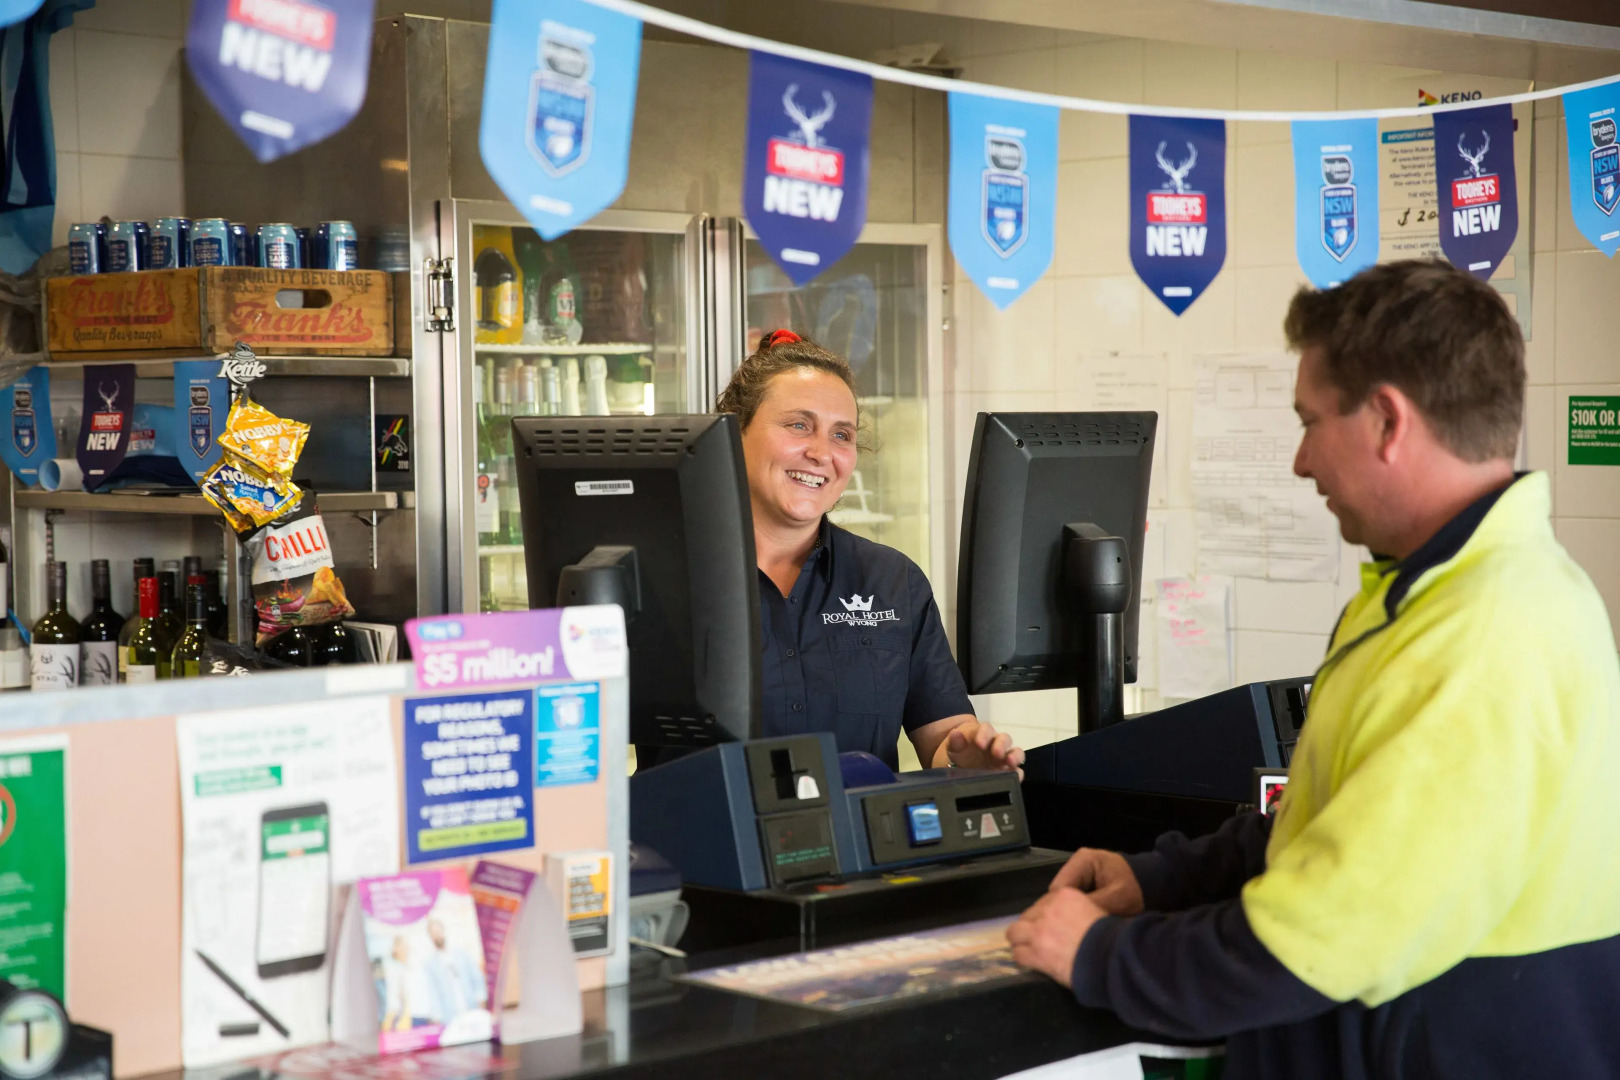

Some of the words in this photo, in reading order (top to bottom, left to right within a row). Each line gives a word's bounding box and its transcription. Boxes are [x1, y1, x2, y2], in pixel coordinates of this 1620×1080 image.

[219, 22, 333, 93] NEW
[1441, 90, 1482, 105] KENO
[1592, 124, 1614, 136] brydens
[1594, 154, 1618, 174] NSW
[763, 175, 843, 222] NEW
[1456, 179, 1496, 200] TOOHEYS
[1152, 196, 1201, 217] TOOHEYS
[1325, 197, 1353, 214] NSW
[1453, 204, 1501, 237] NEW
[1146, 225, 1208, 257] NEW
[236, 269, 296, 285] QUALITY
[301, 270, 372, 287] BEVERAGE
[65, 274, 172, 317] Frank's
[225, 302, 364, 335] Frank's
[73, 327, 107, 343] Quality
[109, 326, 162, 343] Beverages
[217, 360, 267, 386] Kettle
[94, 414, 120, 426] TOOHEYS
[1571, 409, 1597, 426] $10K
[1599, 409, 1615, 426] OR
[86, 432, 121, 451] NEW
[265, 525, 326, 562] CHILLI
[821, 612, 859, 624] ROYAL
[862, 609, 900, 620] HOTEL
[423, 652, 458, 687] $5
[462, 645, 555, 681] million!
